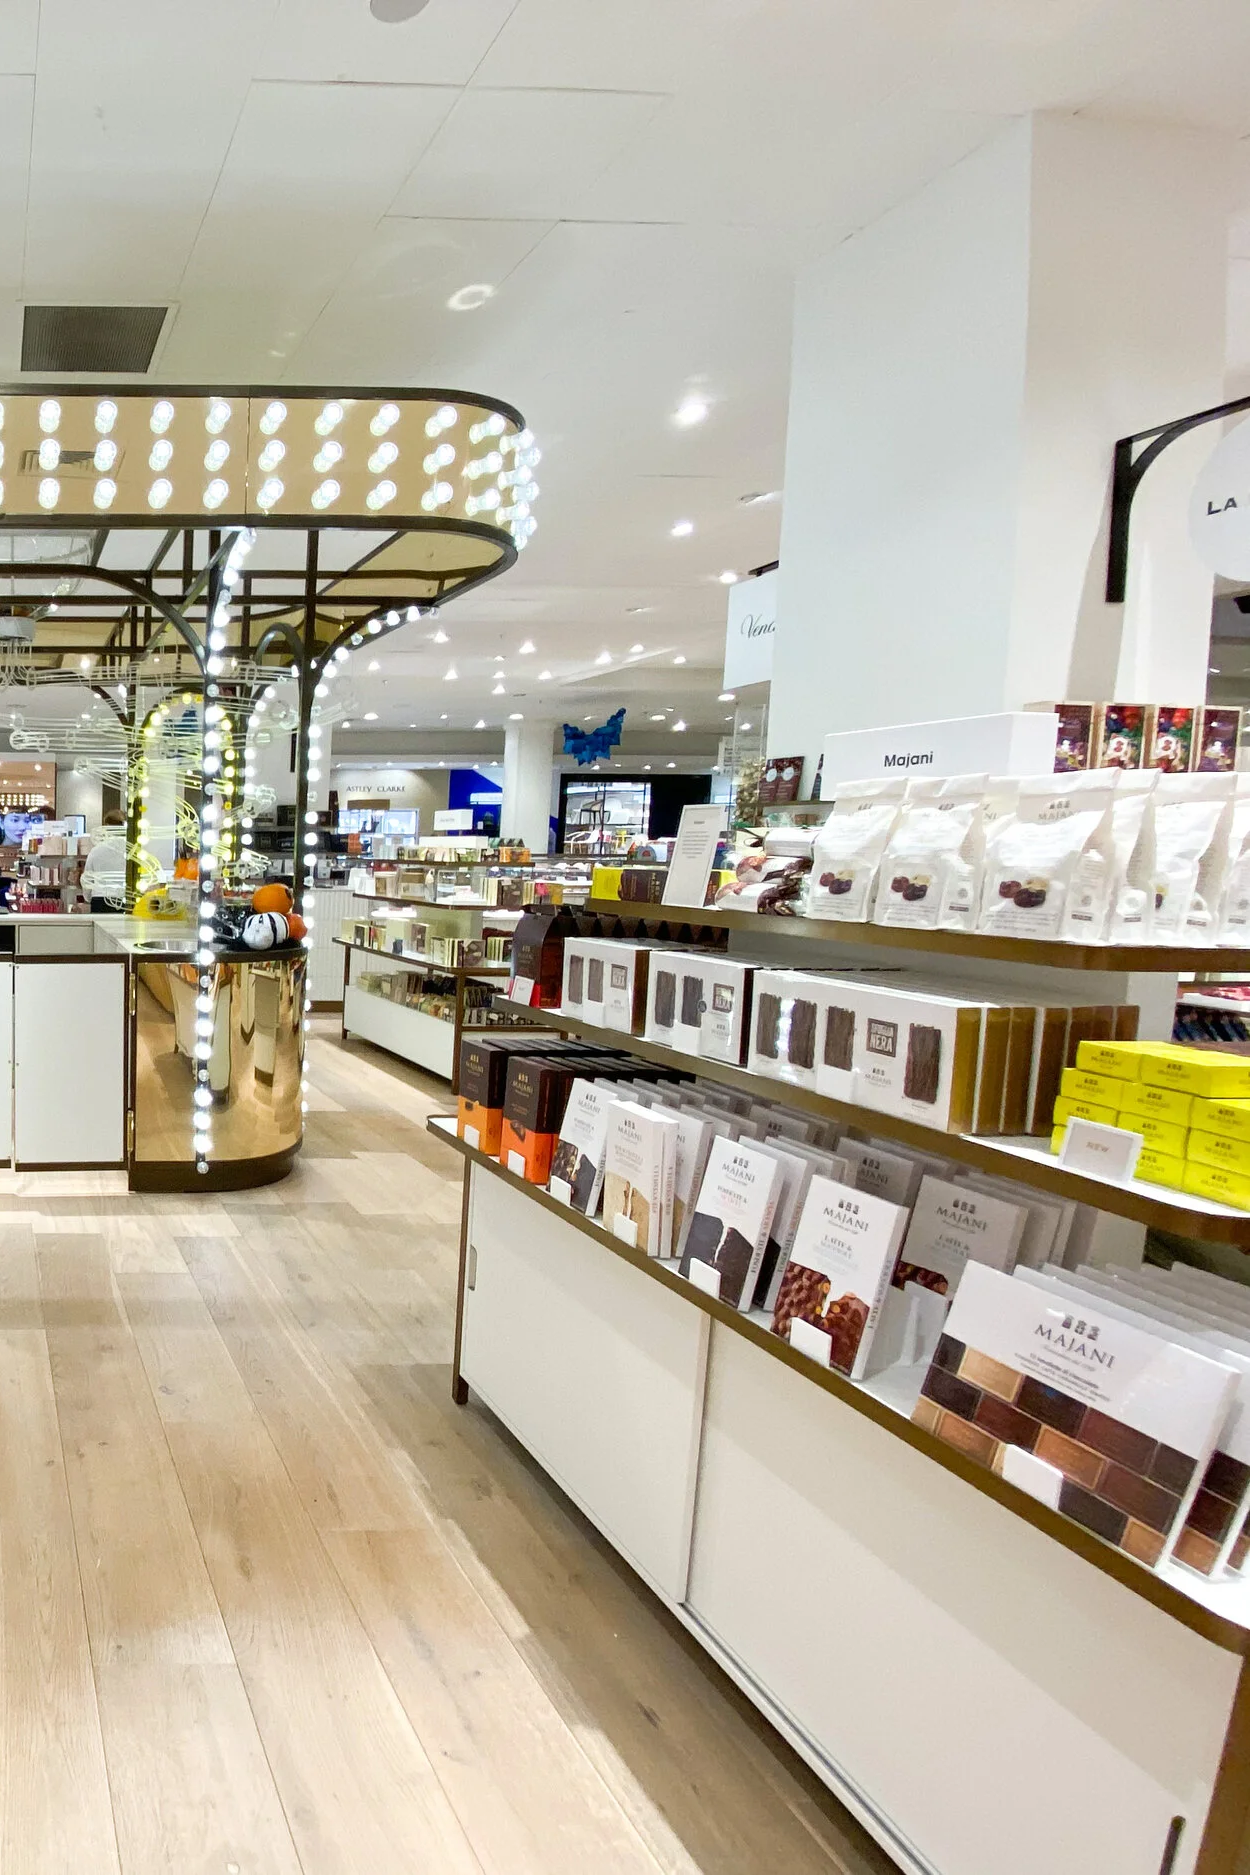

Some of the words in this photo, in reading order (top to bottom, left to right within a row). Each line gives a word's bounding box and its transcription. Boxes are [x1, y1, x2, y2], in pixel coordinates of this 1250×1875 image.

[1207, 497, 1238, 515] LA
[884, 751, 934, 768] Majani
[1038, 809, 1081, 820] MAJAN
[870, 1033, 893, 1052] NERA
[722, 1163, 755, 1183] MAJANI
[860, 1168, 888, 1185] AJANI
[823, 1206, 869, 1232] MAJANI
[937, 1206, 987, 1231] MAJANI
[1035, 1324, 1115, 1368] MAJANI
